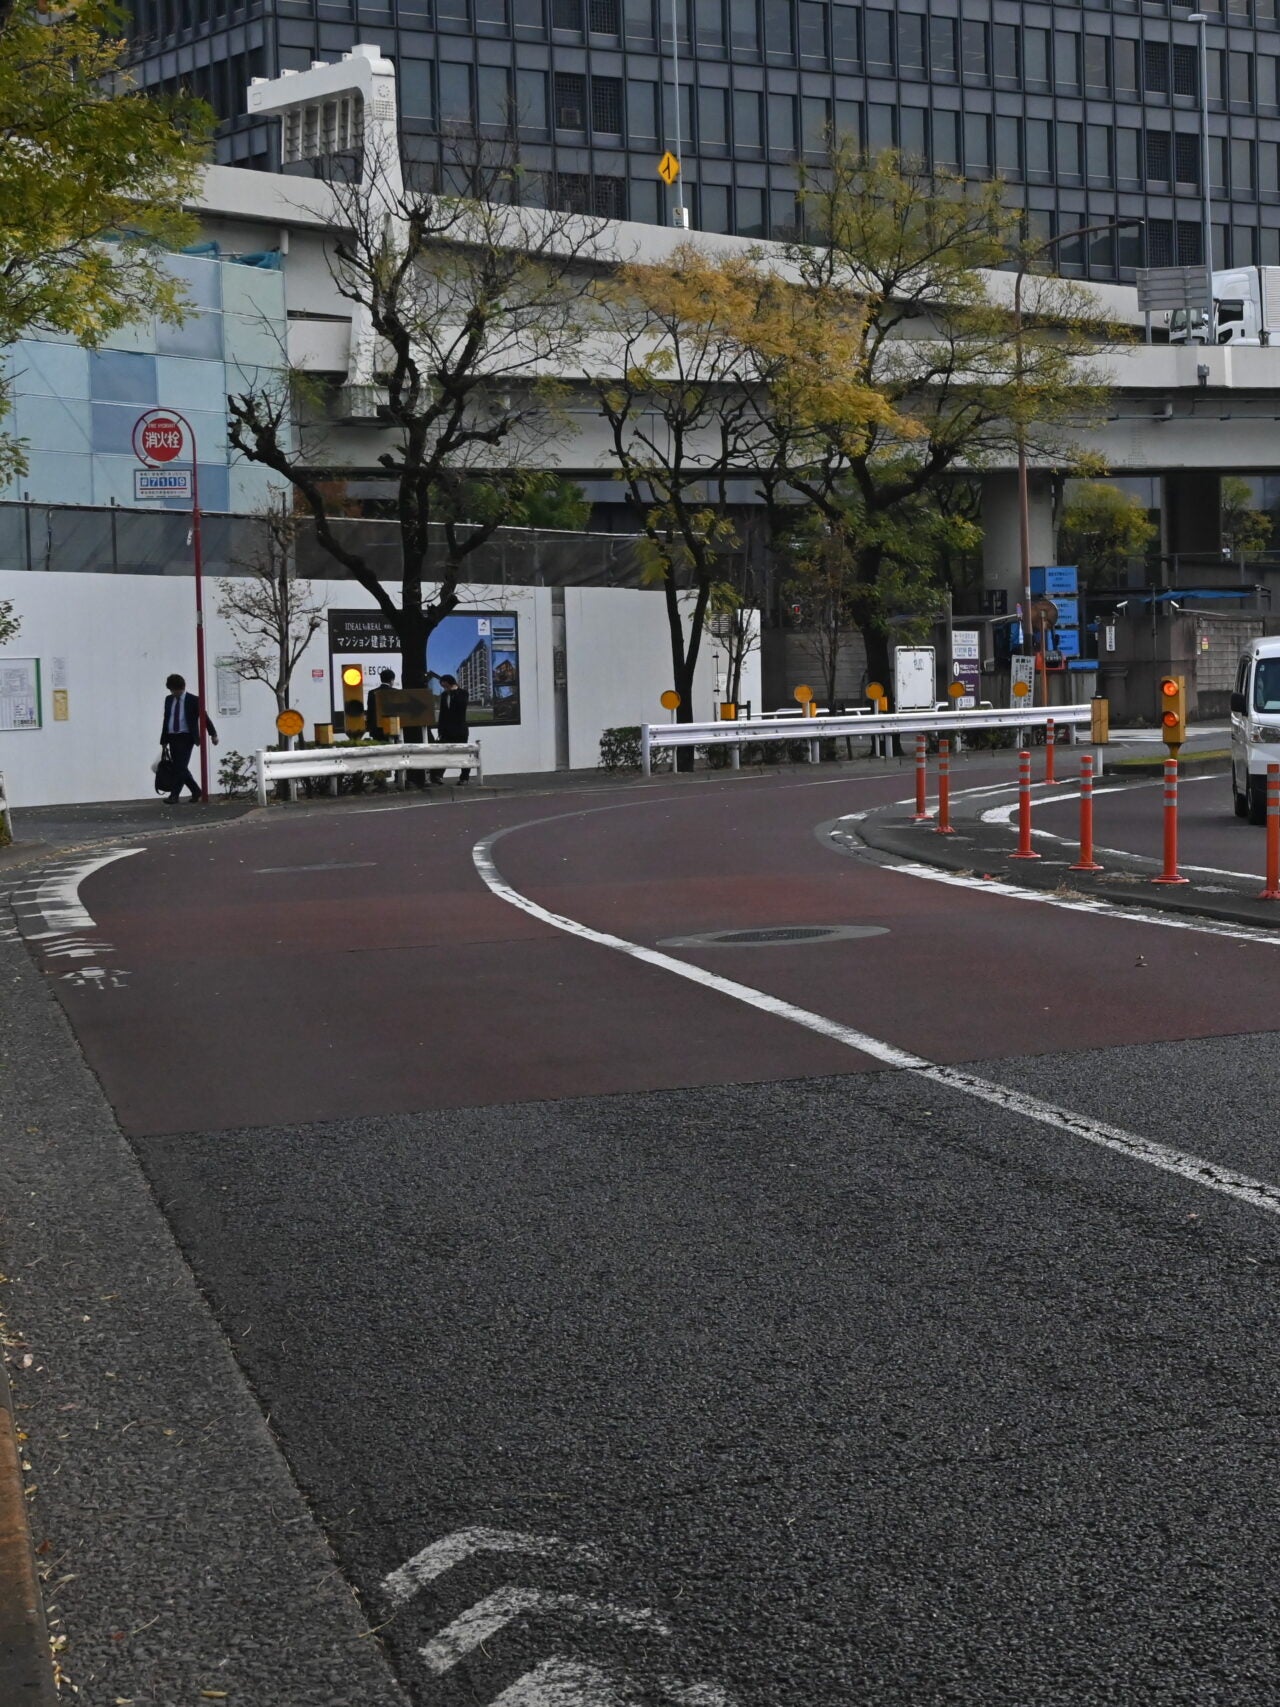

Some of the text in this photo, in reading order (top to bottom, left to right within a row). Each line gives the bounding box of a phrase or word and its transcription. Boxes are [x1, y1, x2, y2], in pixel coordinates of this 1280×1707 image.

[145, 431, 180, 449] 消火栓
[141, 477, 187, 487] #7119
[344, 622, 362, 630] IDEAL
[368, 622, 382, 630] REAL
